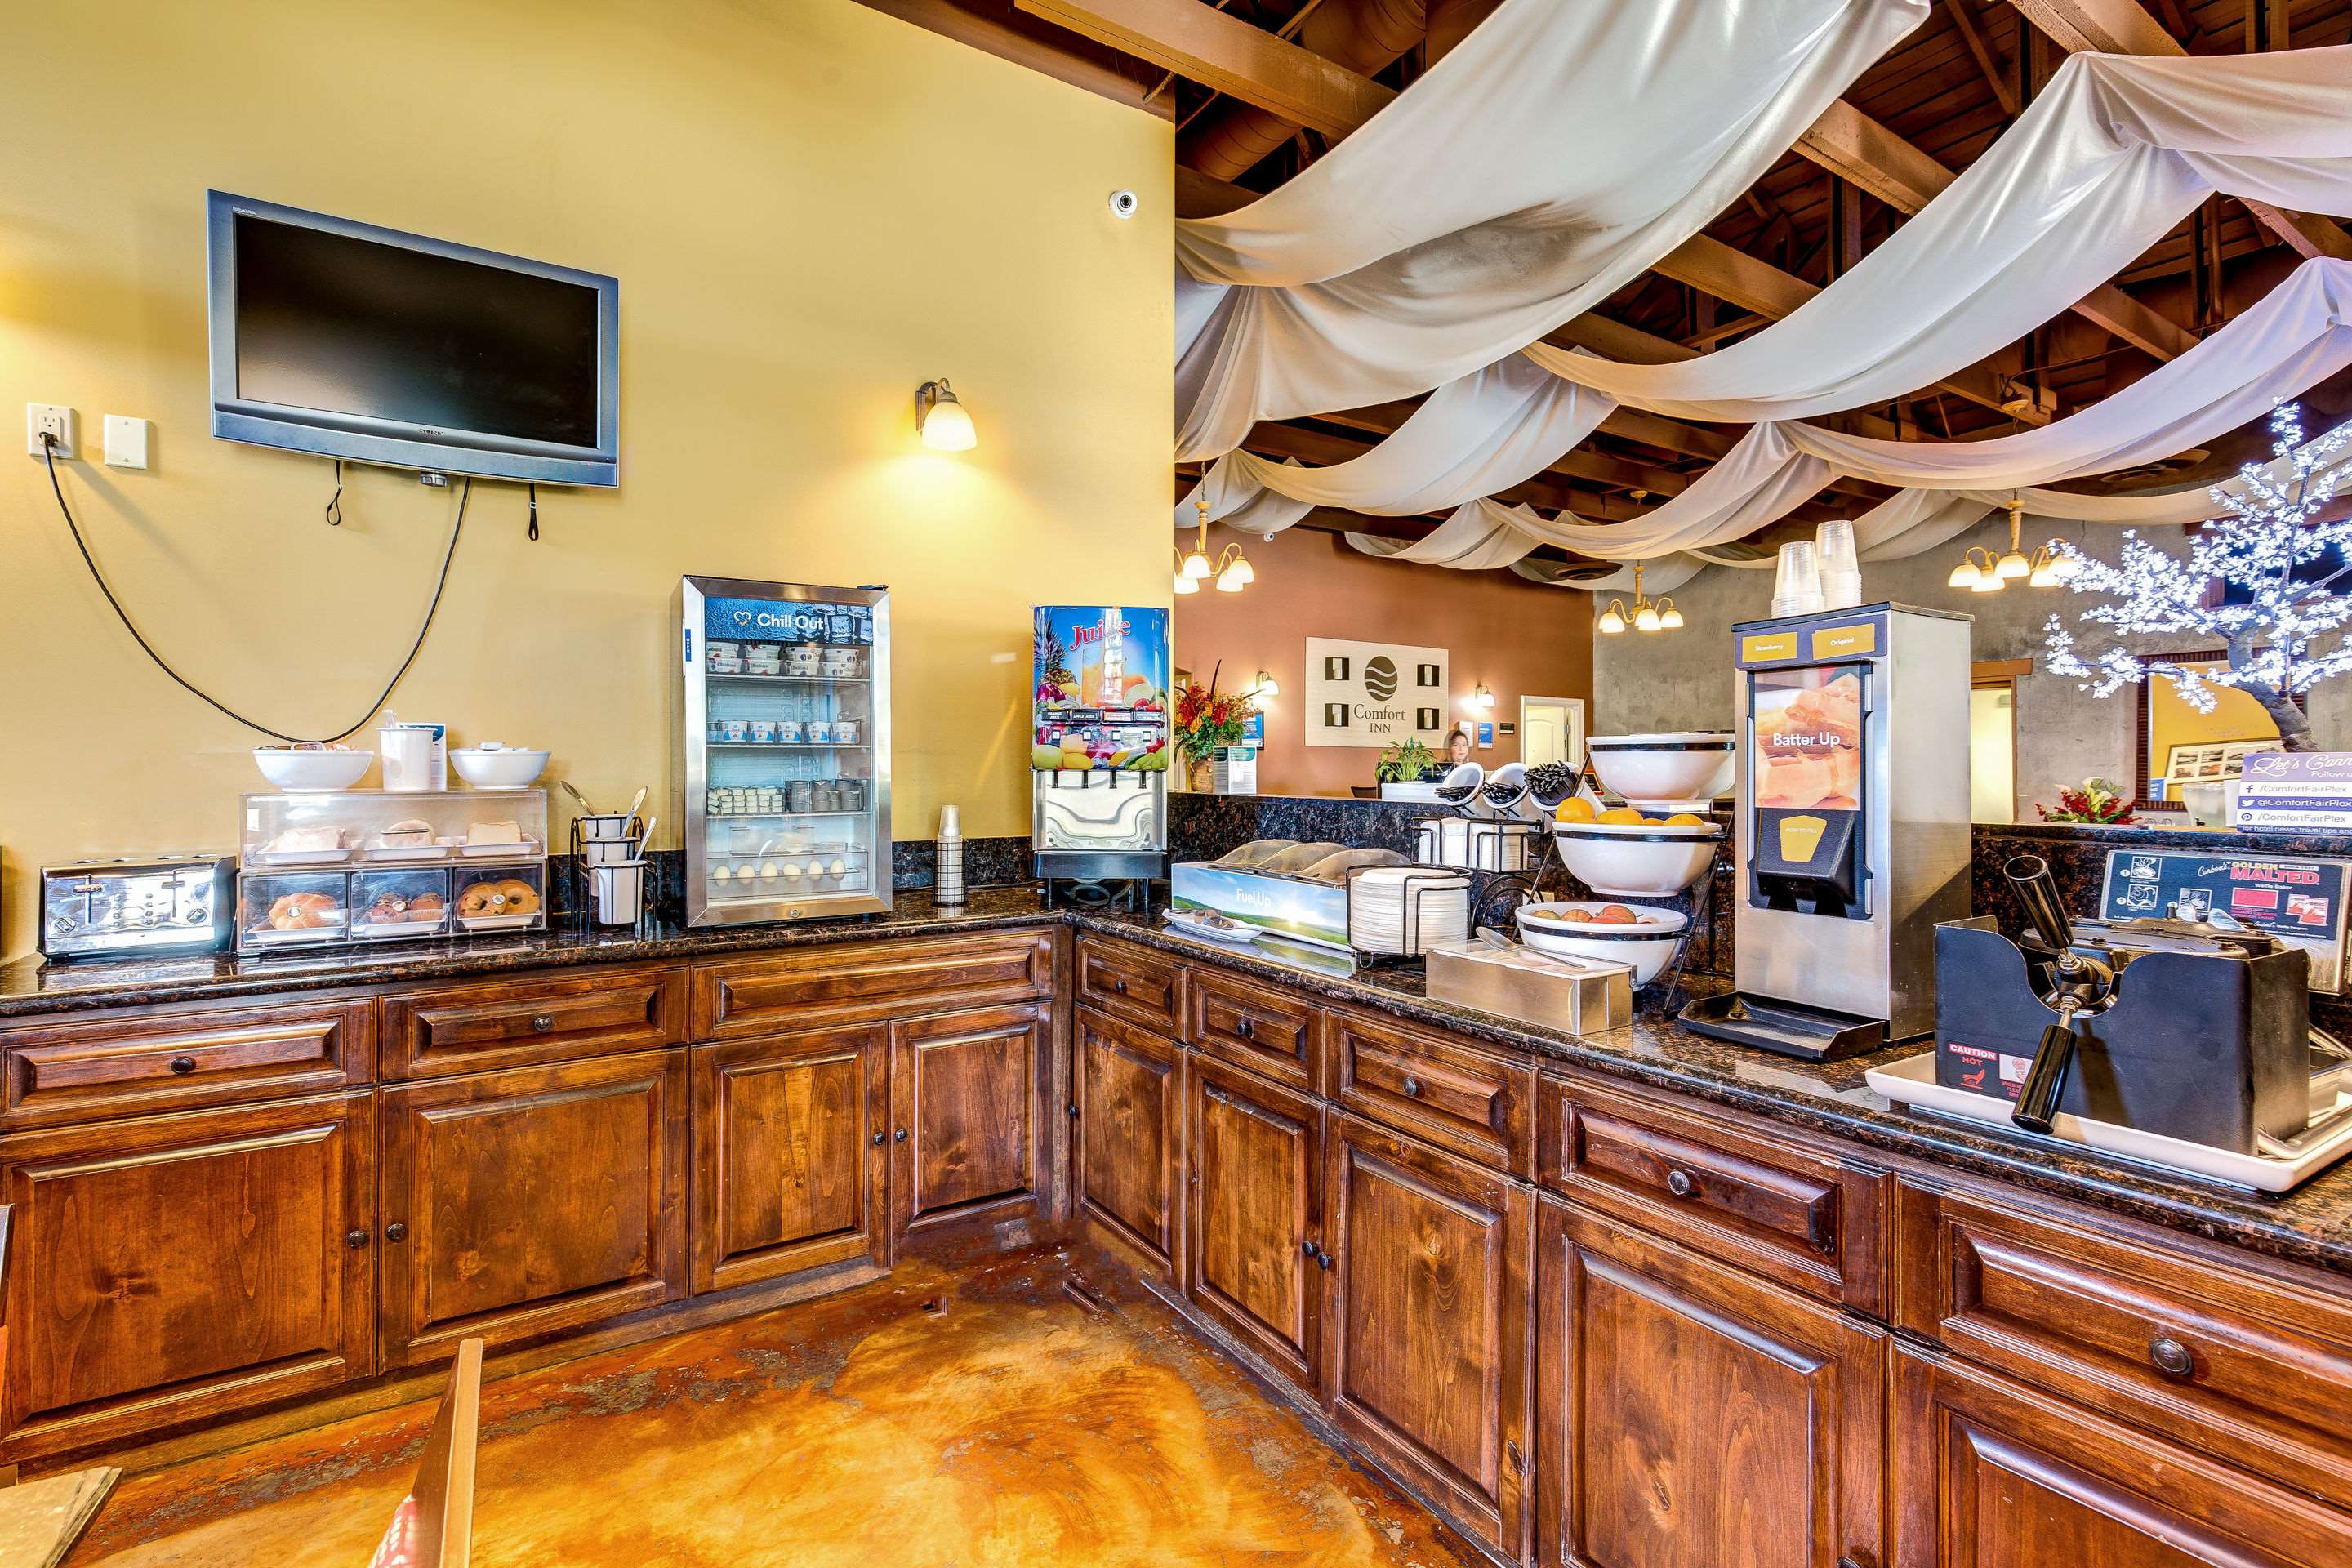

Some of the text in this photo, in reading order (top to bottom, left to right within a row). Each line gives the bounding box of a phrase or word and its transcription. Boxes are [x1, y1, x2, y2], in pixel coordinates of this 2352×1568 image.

[757, 612, 824, 630] Chill Out
[1069, 618, 1131, 651] Juie
[1830, 636, 1855, 647] Original
[1353, 703, 1407, 721] Comfort
[1370, 723, 1392, 733] INN
[1772, 731, 1841, 749] Batter Up
[2250, 756, 2301, 777] Let's
[2259, 784, 2348, 793] /ComfortFairPlex
[2257, 798, 2352, 808] @ComfortFairPlex
[2257, 813, 2347, 823] /ComfortFairPlex
[2231, 861, 2278, 871] GOLDEN
[2230, 867, 2319, 884] MALTED
[1236, 888, 1272, 907] Fuel Up
[1950, 1044, 1995, 1059] CAUTION
[1962, 1056, 1983, 1066] HOT
